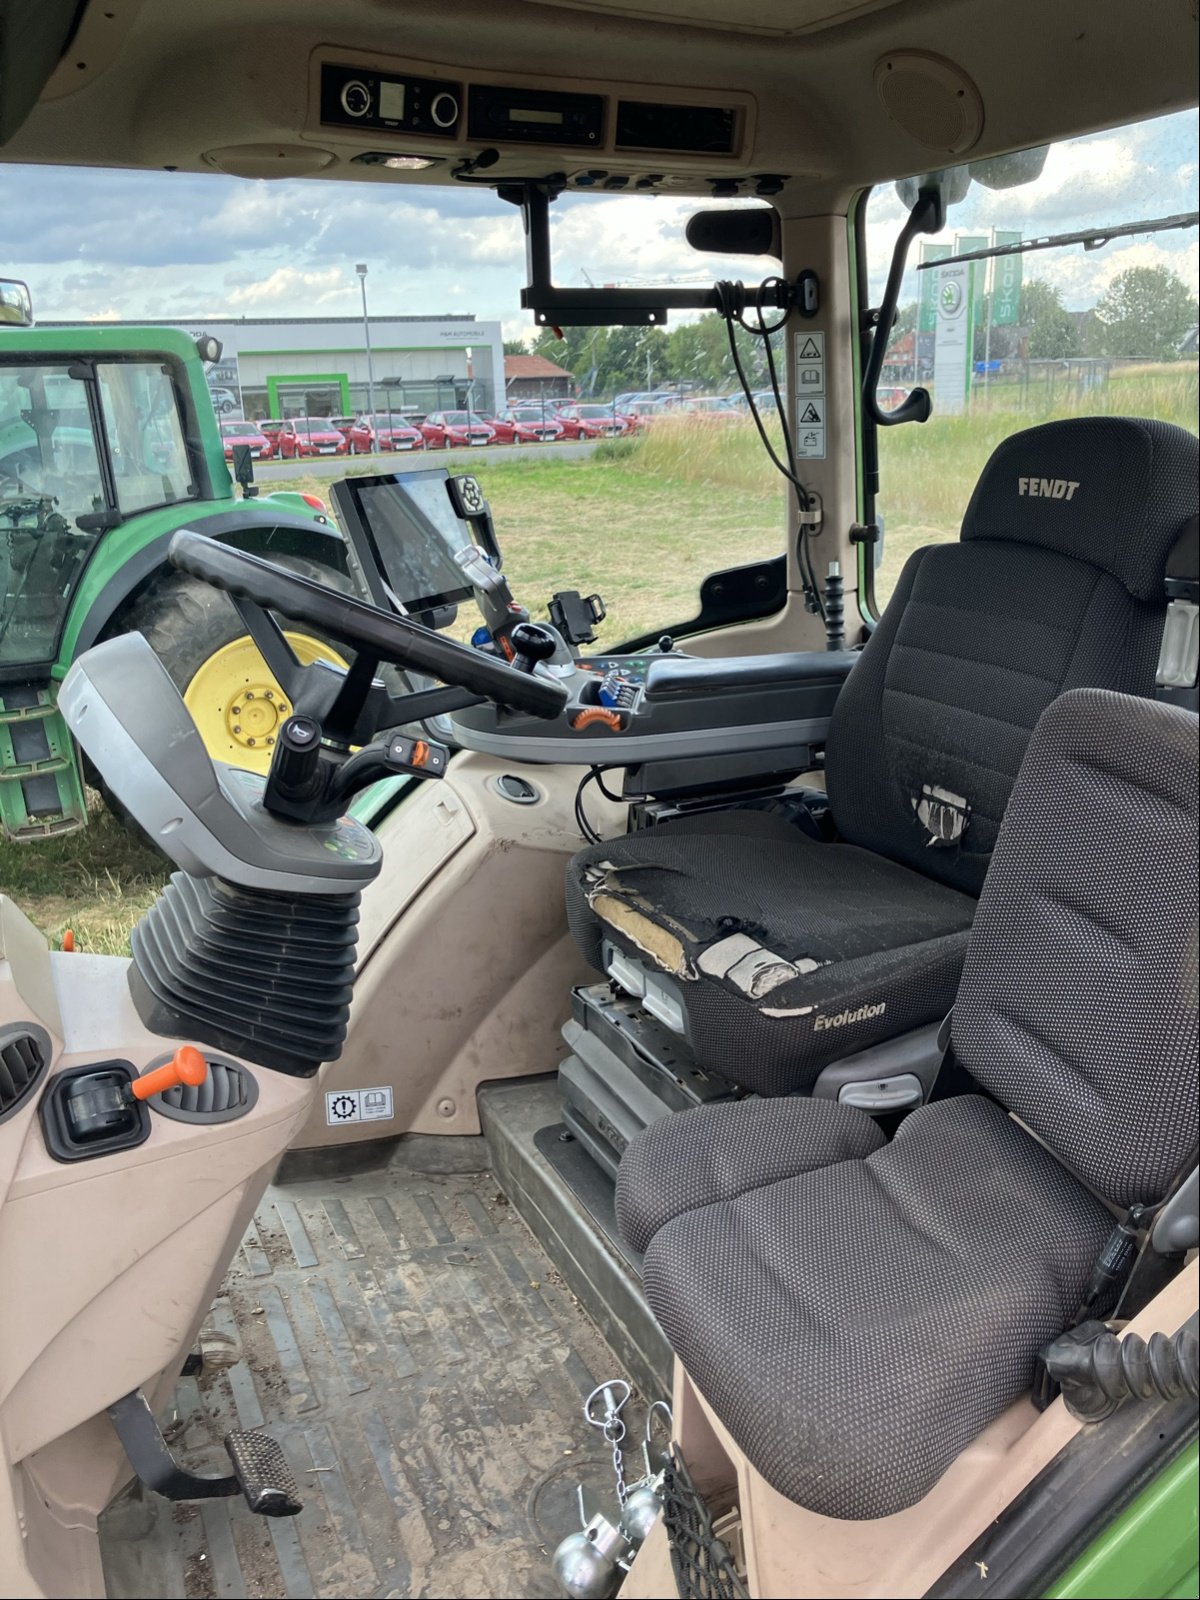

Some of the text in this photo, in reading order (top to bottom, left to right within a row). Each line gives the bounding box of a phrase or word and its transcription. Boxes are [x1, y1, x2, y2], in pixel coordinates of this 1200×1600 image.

[1000, 250, 1014, 318] ŠKOD
[1018, 477, 1080, 501] FENDT
[813, 1002, 886, 1031] Evolution
